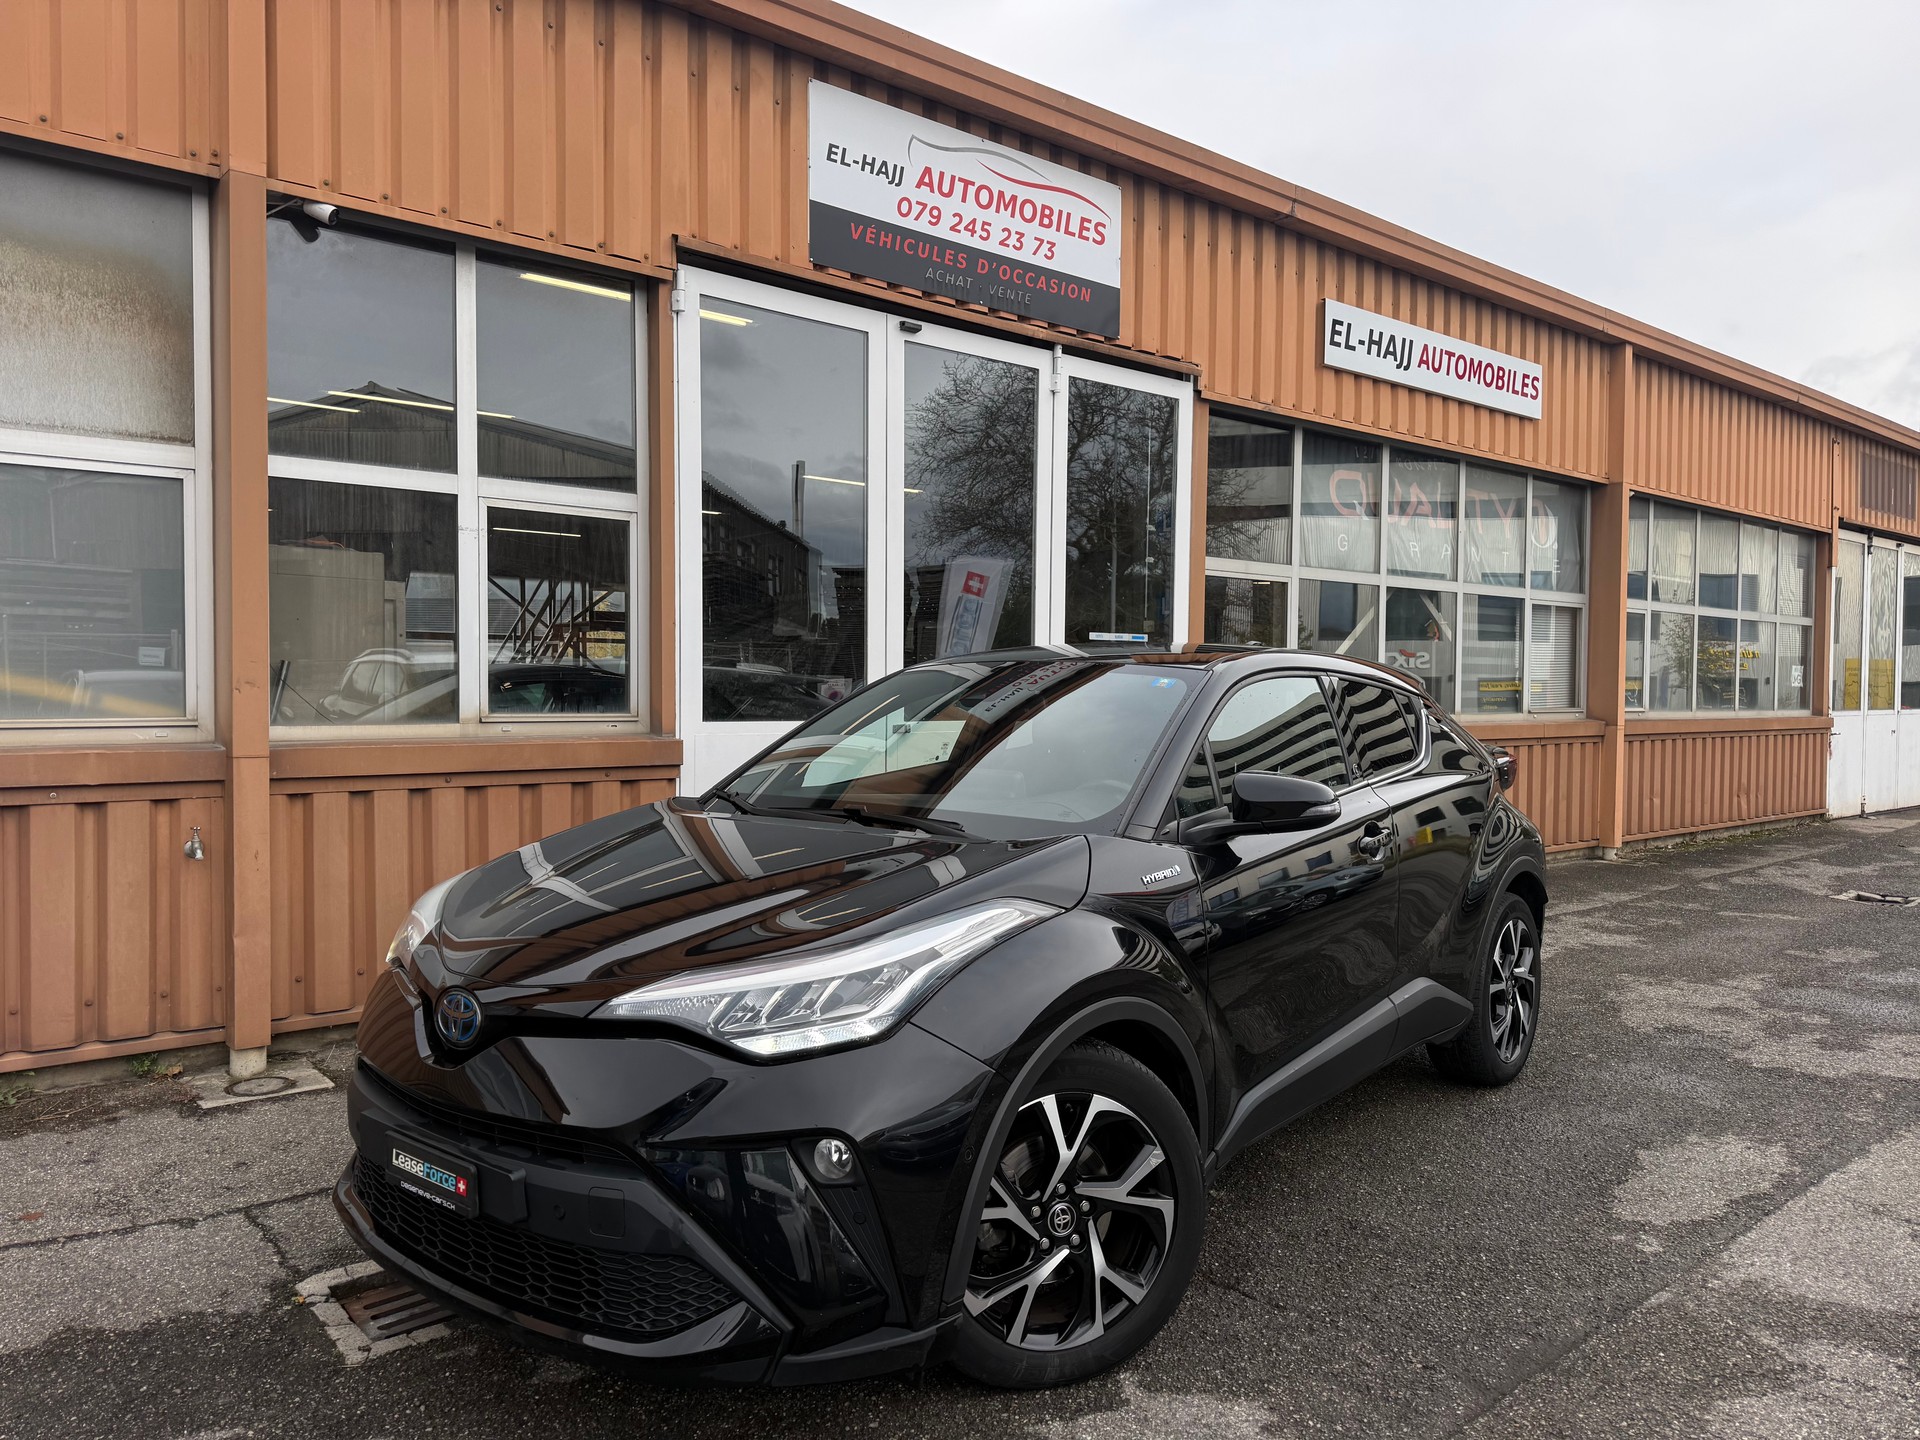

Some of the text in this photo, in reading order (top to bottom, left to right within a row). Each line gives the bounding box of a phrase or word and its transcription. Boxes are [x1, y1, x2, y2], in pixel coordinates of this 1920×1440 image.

[826, 142, 1107, 247] EL-HAJJ AUTOMOBILES
[896, 196, 1057, 261] 079 245 23 73
[850, 222, 1092, 303] VÉHICULES D'OCCASION
[925, 266, 1032, 305] ACHAT VENTE
[1328, 318, 1540, 401] EL-HAJJ AUTOMOBILES
[1329, 469, 1517, 539] QUALTY
[1141, 867, 1175, 886] HYBRID
[392, 1148, 457, 1191] LeaseForce
